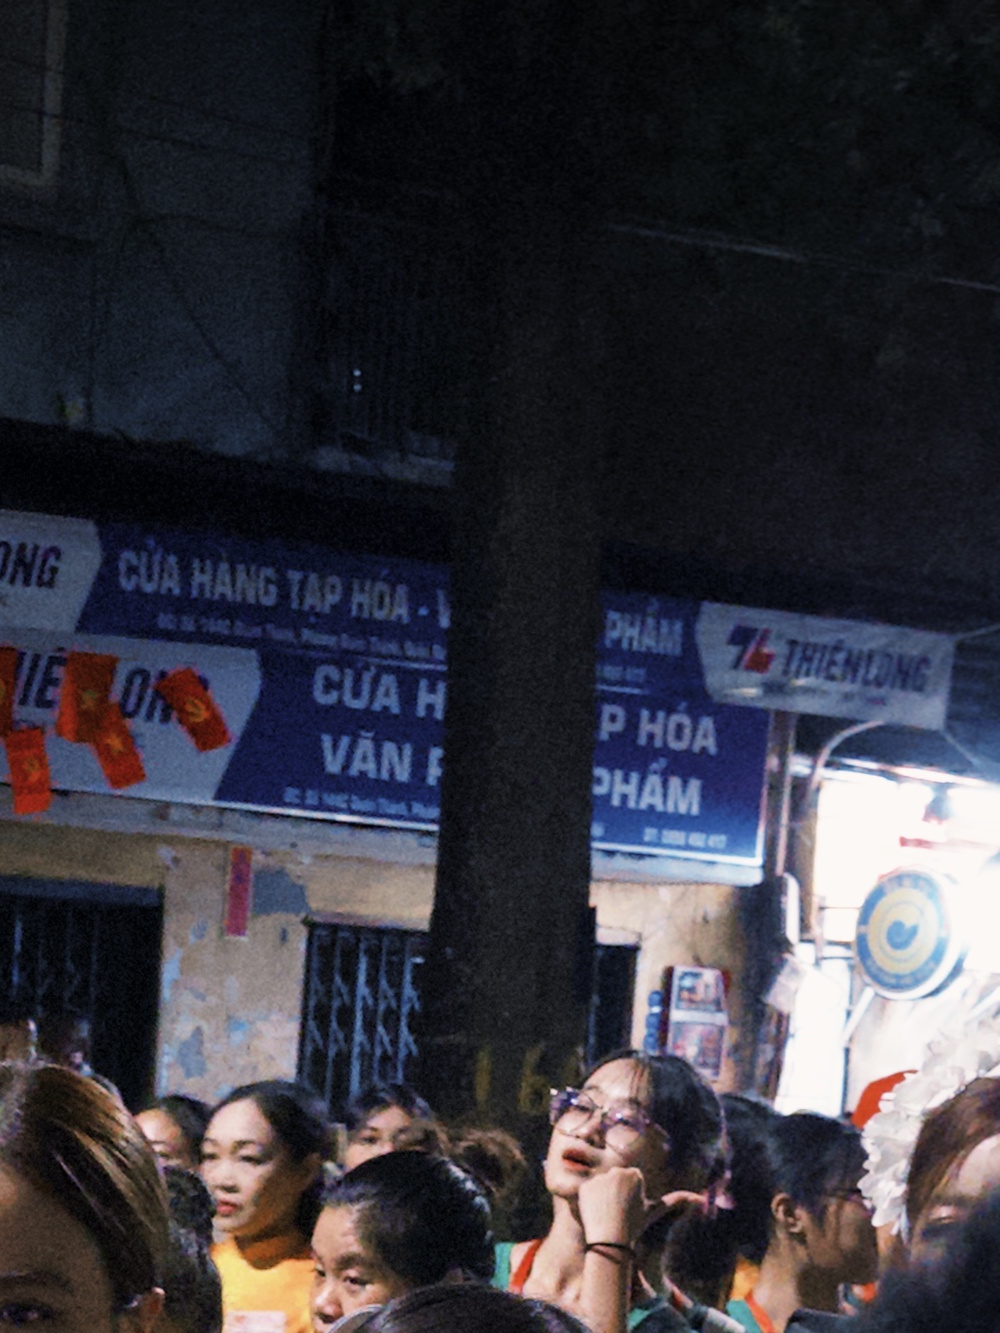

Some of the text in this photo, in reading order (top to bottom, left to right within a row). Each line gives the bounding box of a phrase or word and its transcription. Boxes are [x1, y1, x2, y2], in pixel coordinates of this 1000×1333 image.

[190, 549, 278, 606] HÀNG
[286, 569, 343, 624] TẠP
[351, 568, 411, 625] HÓA
[637, 702, 718, 755] HÓA
[320, 729, 413, 783] VĂN
